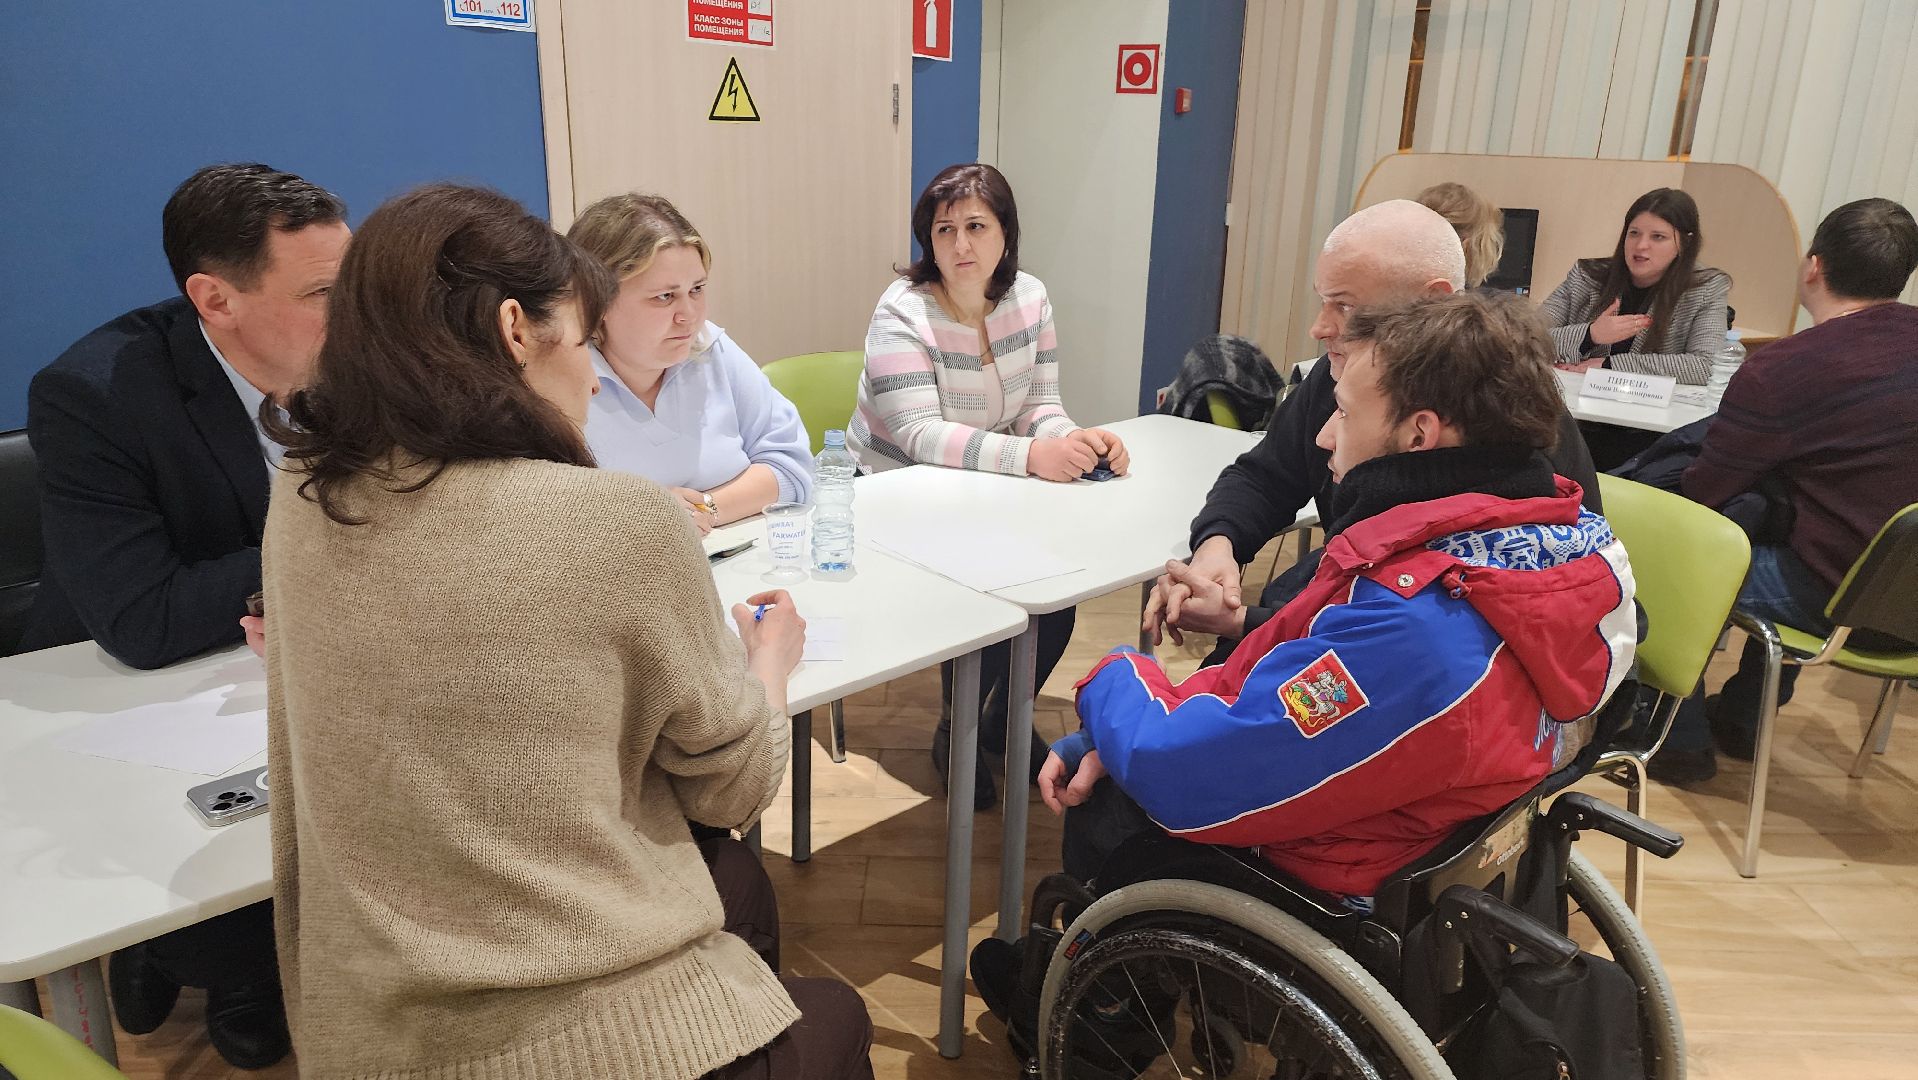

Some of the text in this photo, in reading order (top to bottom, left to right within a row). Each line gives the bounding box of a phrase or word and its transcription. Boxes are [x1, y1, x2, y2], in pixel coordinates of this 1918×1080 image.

[464, 0, 482, 12] 101
[501, 3, 521, 16] 112
[694, 14, 744, 27] КЛАСС ЗОНЫ
[694, 24, 744, 36] ПОМЕЩЕНИЯ
